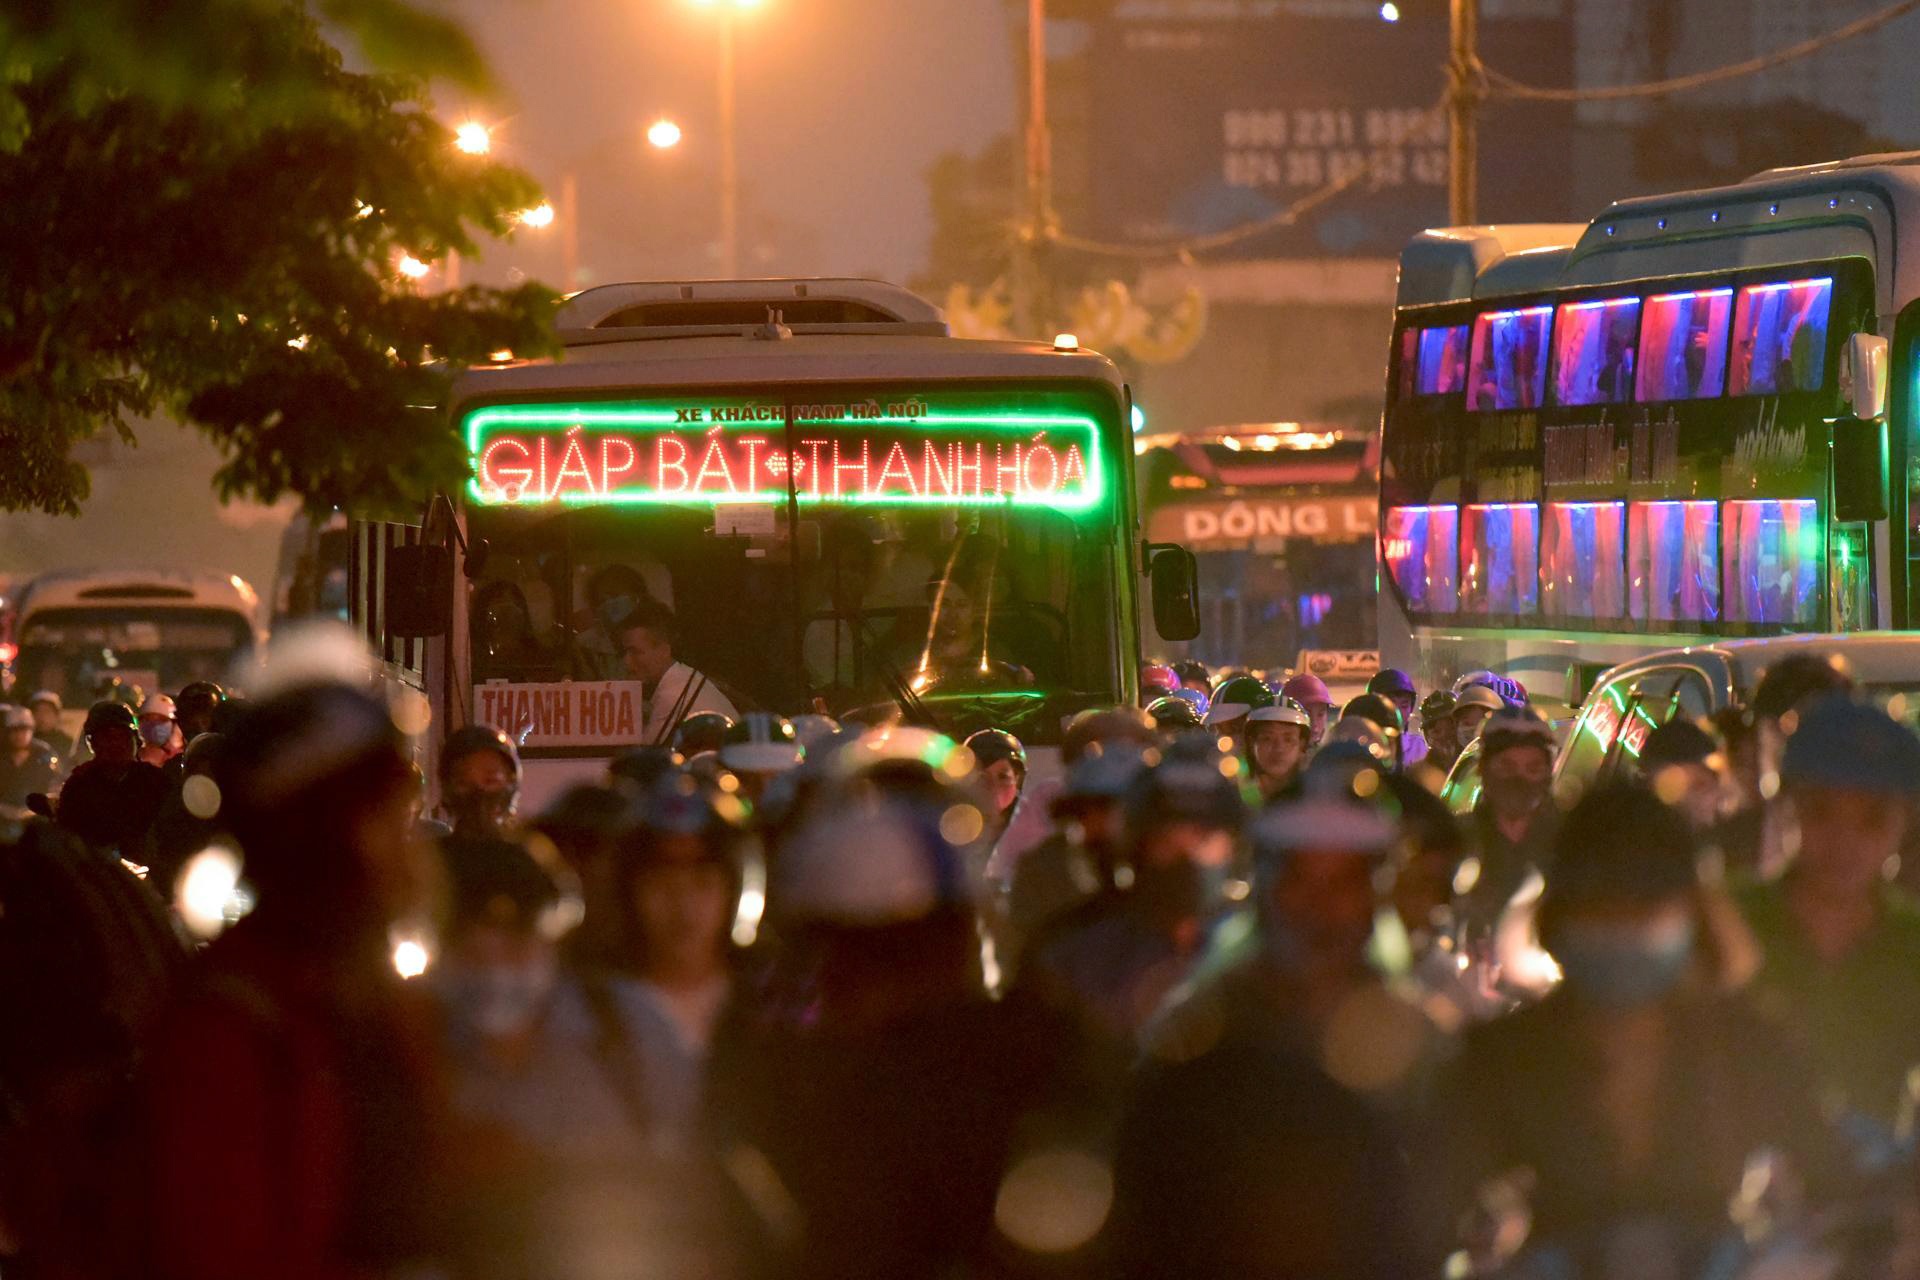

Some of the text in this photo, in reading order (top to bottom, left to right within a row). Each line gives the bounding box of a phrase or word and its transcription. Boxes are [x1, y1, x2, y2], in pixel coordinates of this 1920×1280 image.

[675, 408, 703, 423] XE
[710, 402, 785, 422] KHÁCH
[792, 404, 846, 420] NAM
[852, 400, 881, 419] HÀ
[480, 425, 1087, 497] GIÁP BÁT THANH HÓA
[482, 682, 635, 736] THANH HÓA
